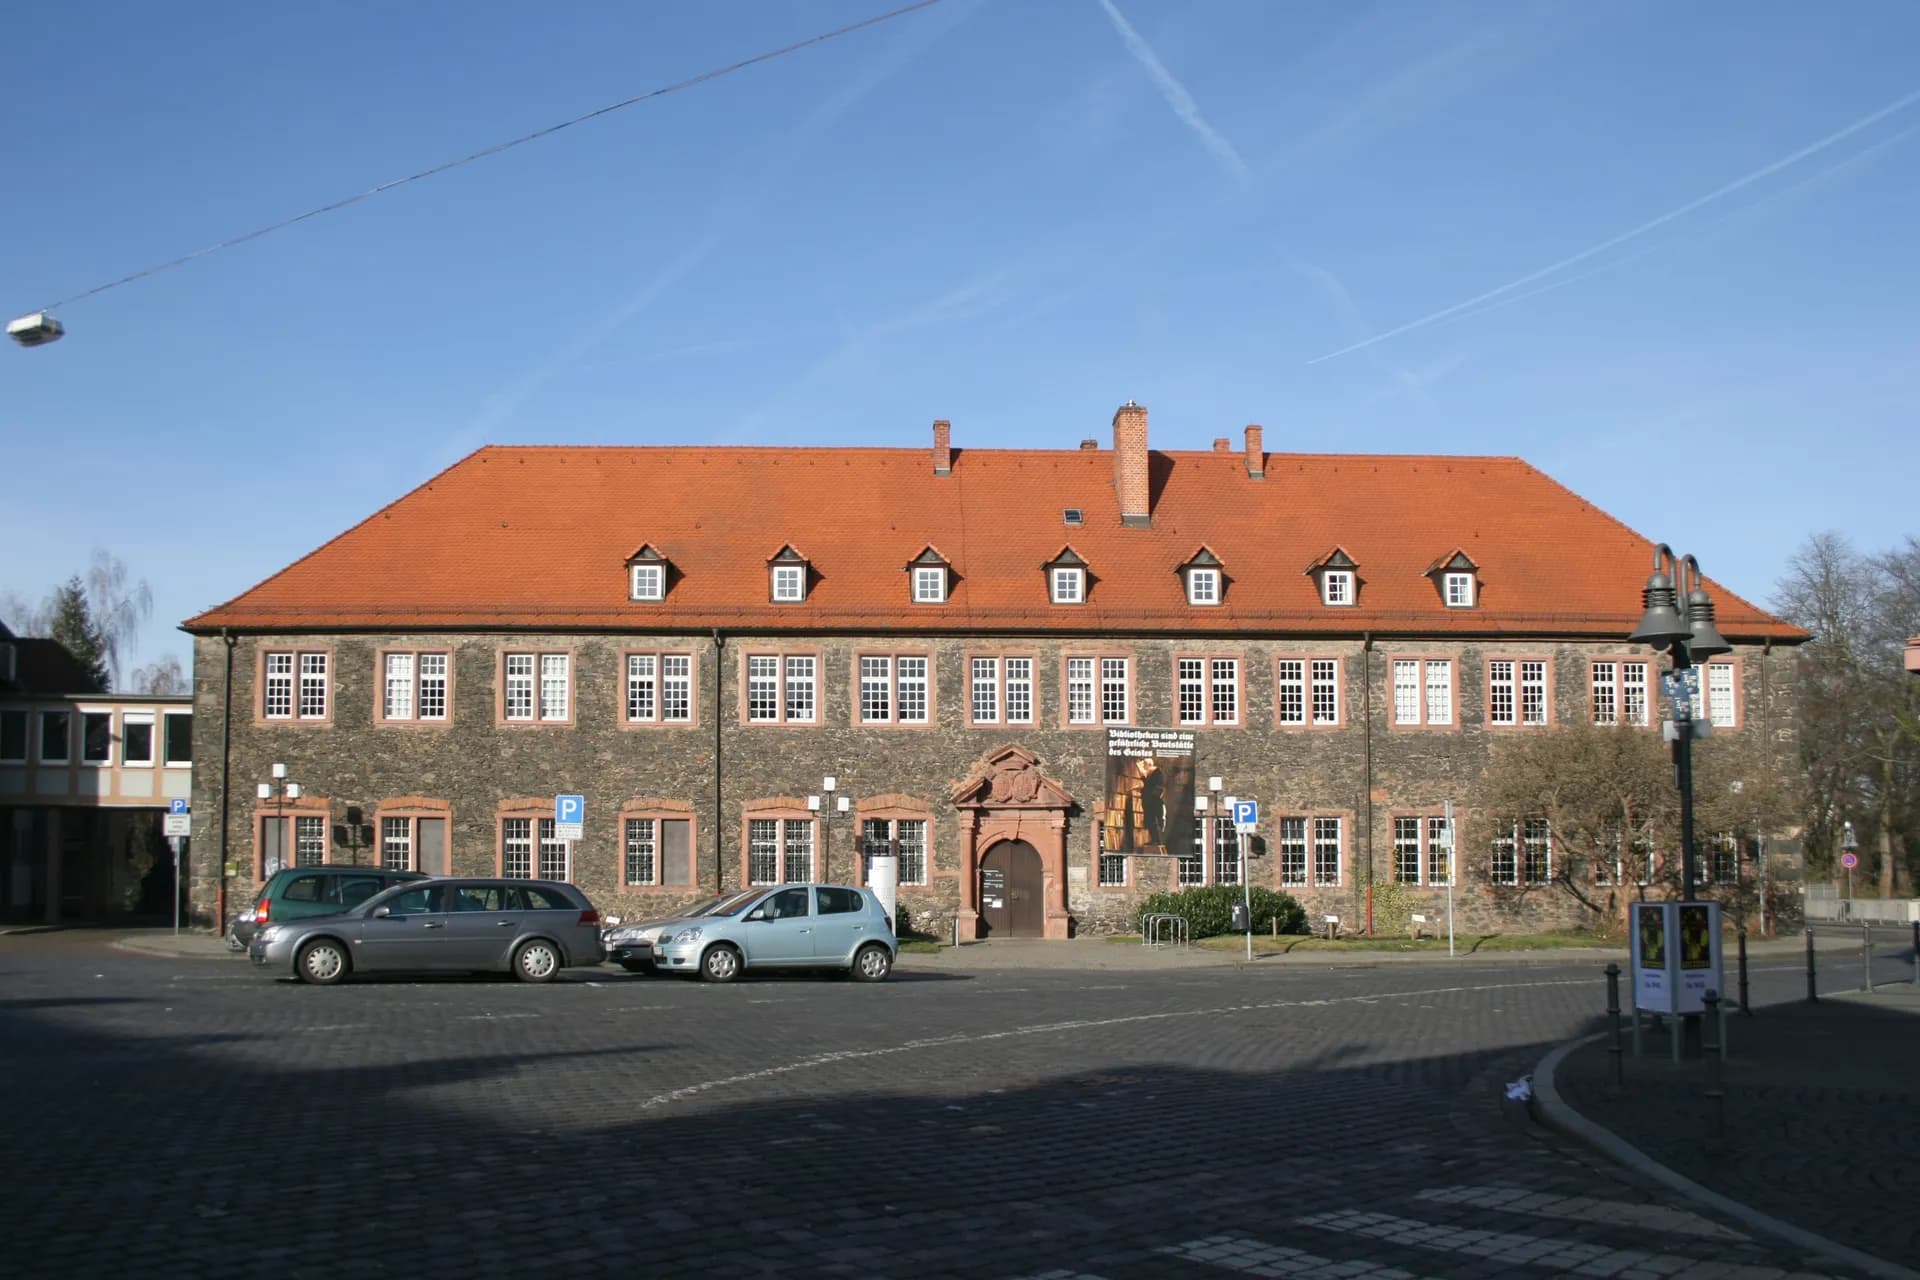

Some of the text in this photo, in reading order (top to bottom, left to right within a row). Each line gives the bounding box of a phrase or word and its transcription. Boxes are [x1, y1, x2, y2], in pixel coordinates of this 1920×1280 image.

[1109, 729, 1194, 740] Bibliotheken sind eine
[1108, 739, 1194, 748] gefährliche Brutstätte
[1108, 748, 1121, 756] des
[1123, 748, 1152, 756] Geistes
[174, 800, 183, 812] P
[562, 800, 576, 820] P
[1239, 805, 1251, 822] P
